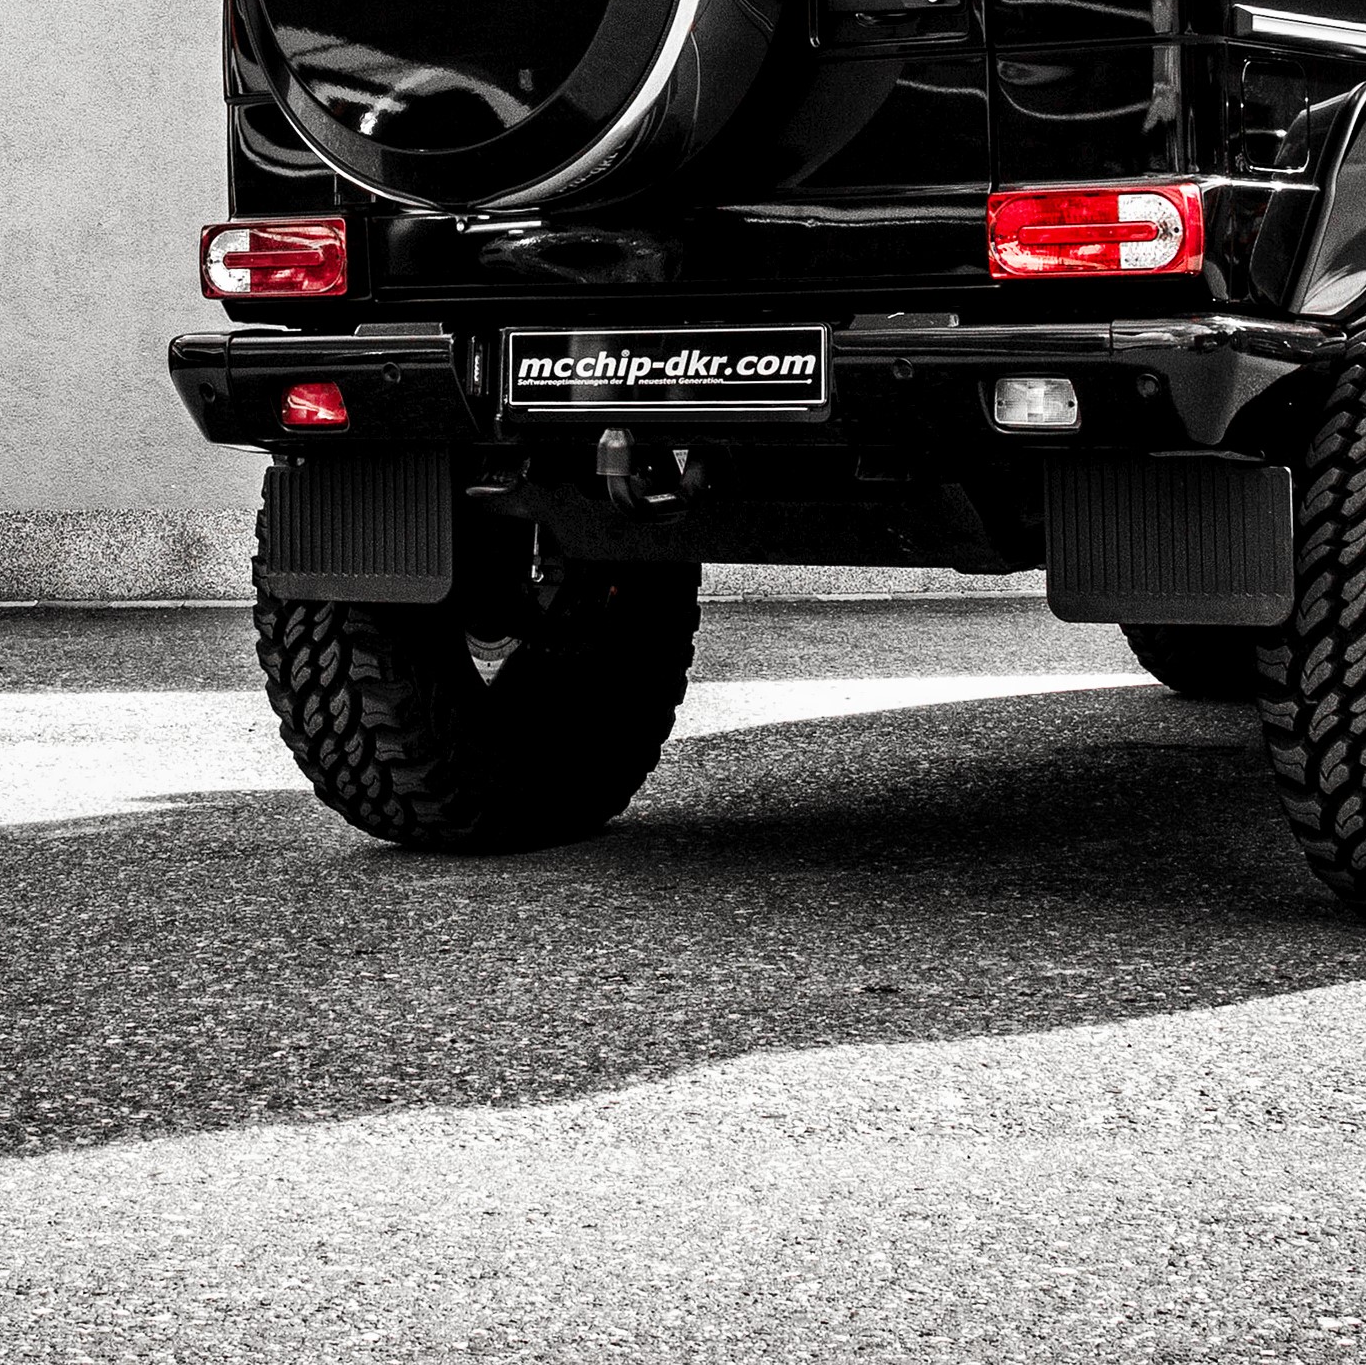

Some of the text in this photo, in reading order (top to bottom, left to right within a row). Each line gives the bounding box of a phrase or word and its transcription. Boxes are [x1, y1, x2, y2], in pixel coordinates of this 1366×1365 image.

[518, 349, 817, 385] mcchip-dkr.com
[517, 378, 609, 387] Softwareoptimierungen
[678, 377, 724, 385] Generation
